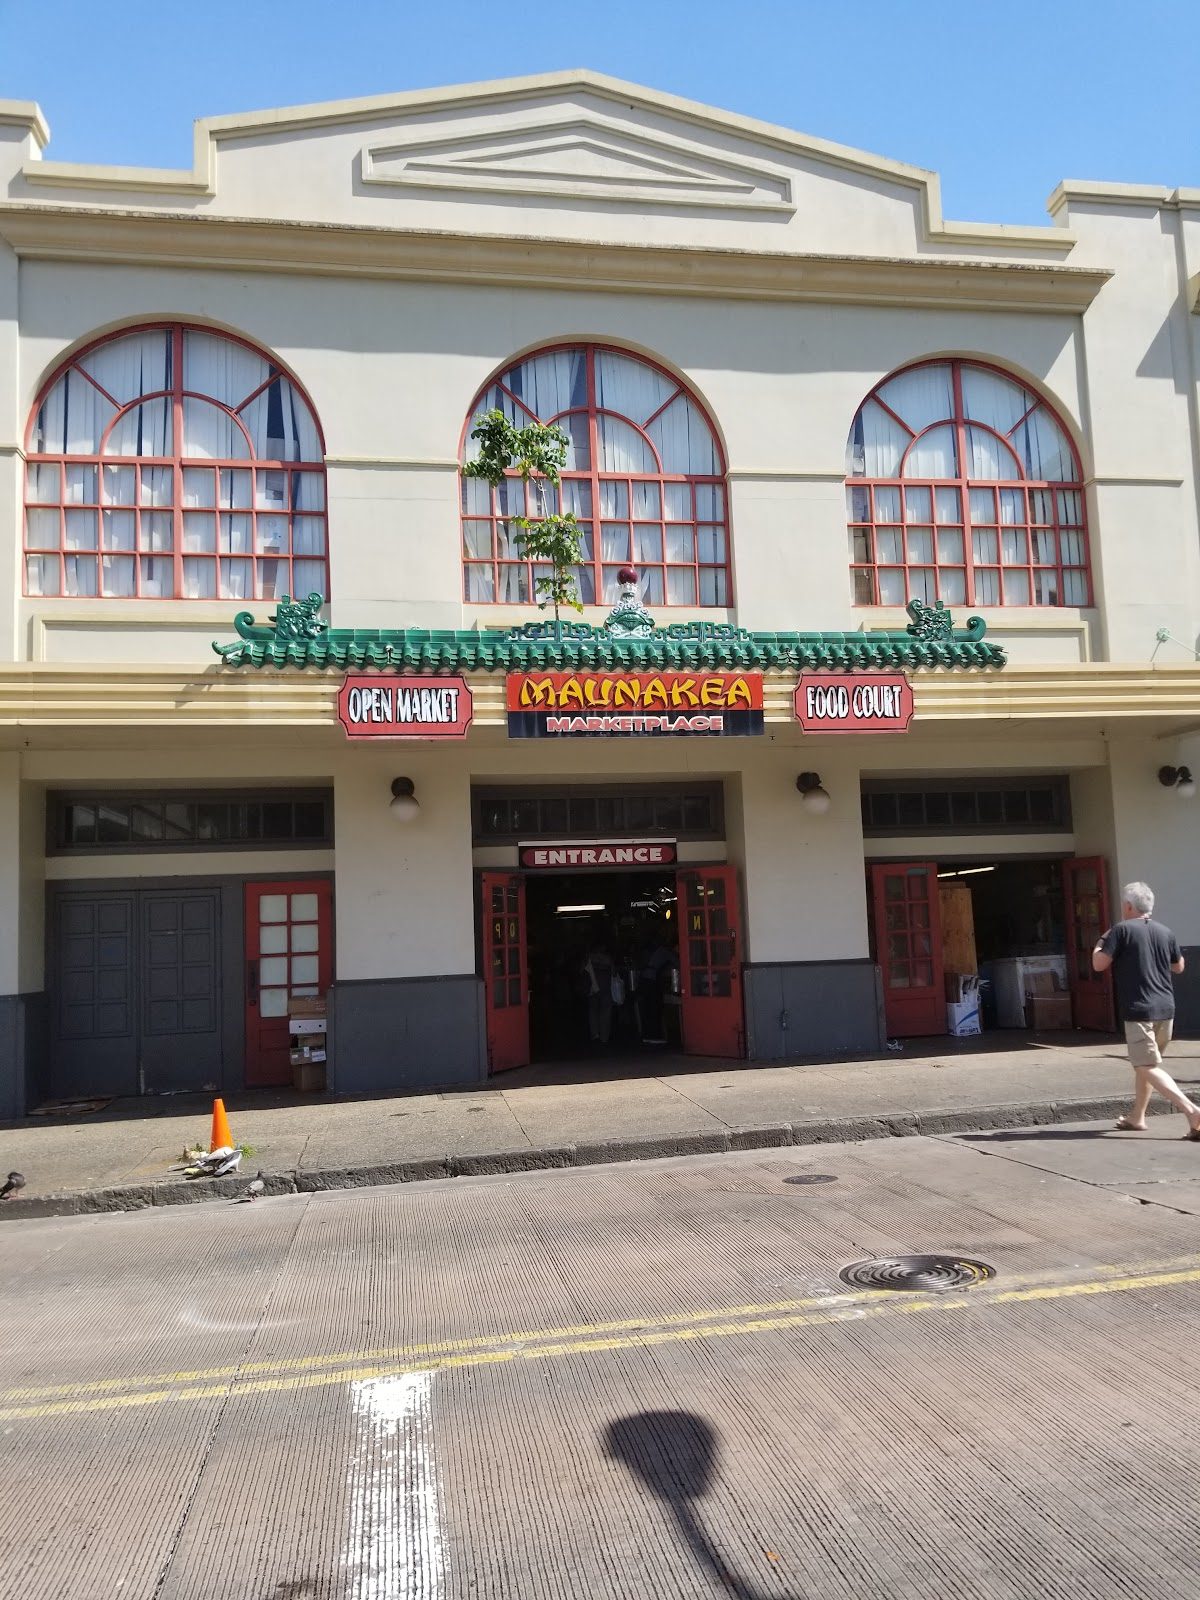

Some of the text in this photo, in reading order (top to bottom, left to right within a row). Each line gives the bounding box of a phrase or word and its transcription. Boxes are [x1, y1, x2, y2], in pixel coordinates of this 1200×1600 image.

[348, 687, 459, 724] OPEN MARKET
[519, 676, 753, 709] MAUNAKEA
[806, 685, 902, 718] FOOD COURT
[546, 715, 723, 732] MARKETPLACE
[534, 847, 663, 865] ENTRANCE
